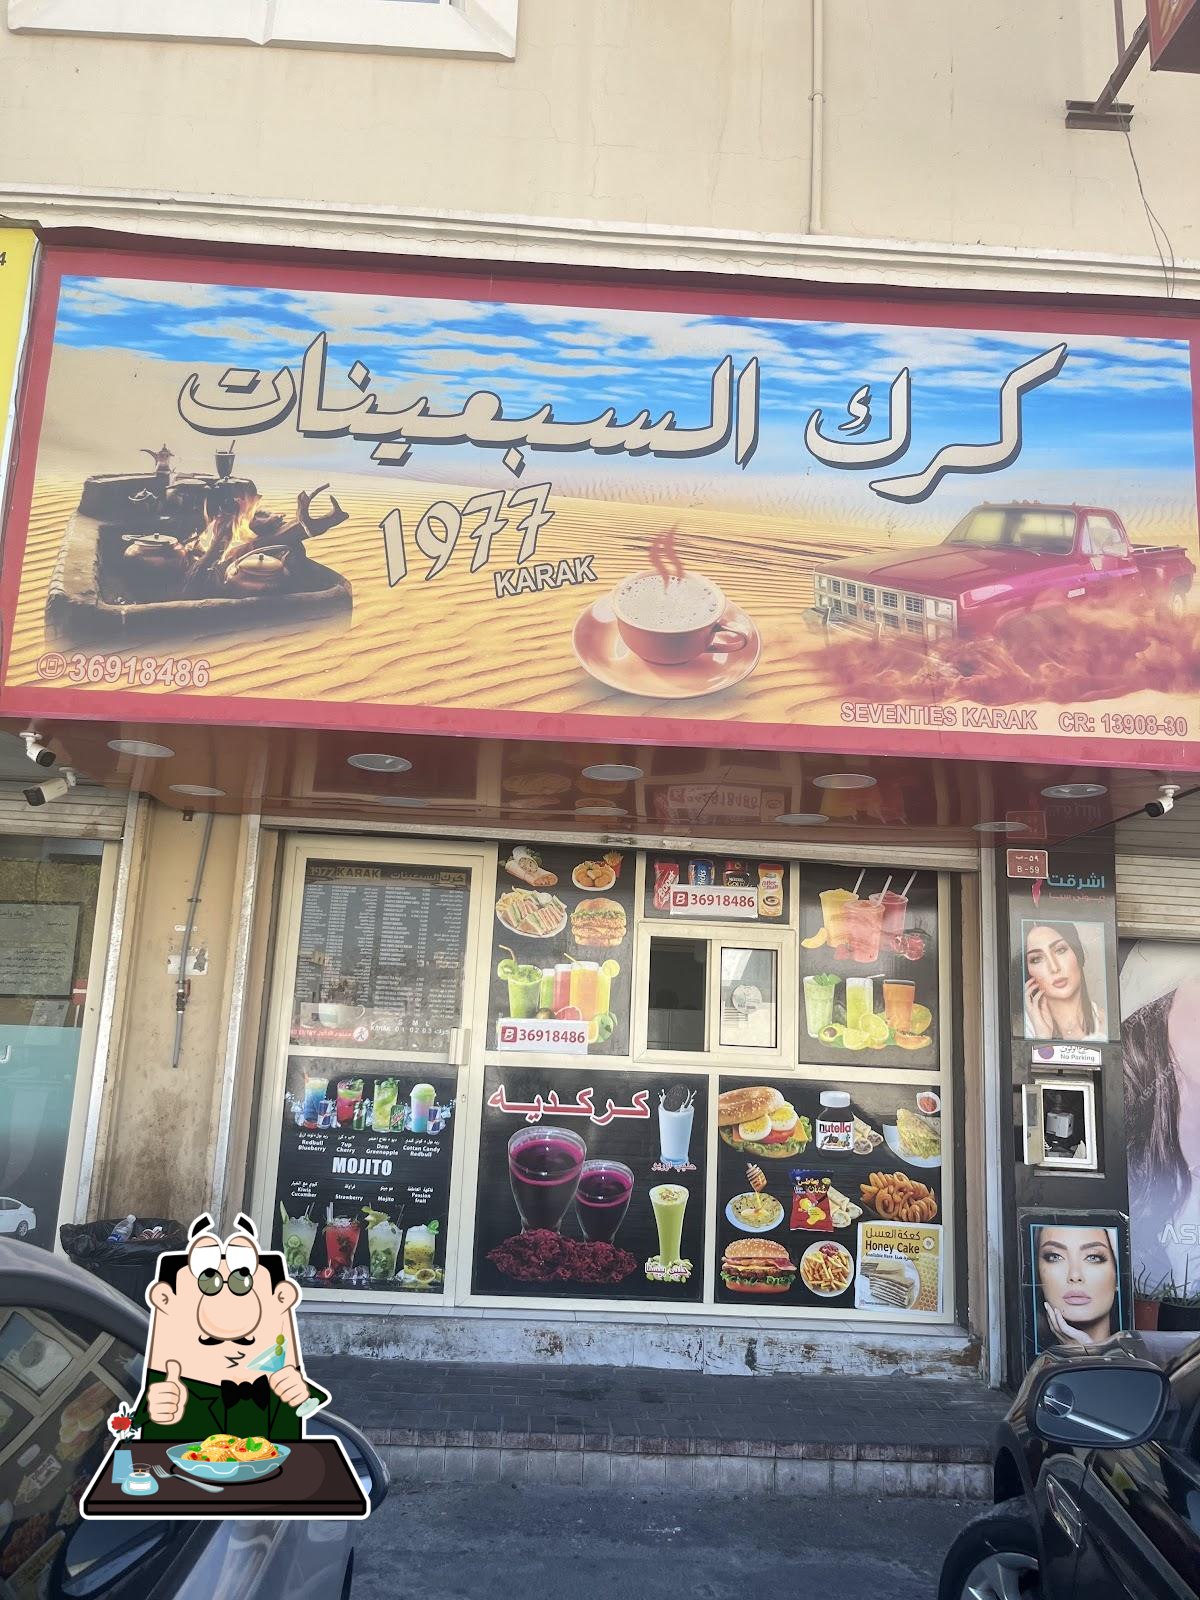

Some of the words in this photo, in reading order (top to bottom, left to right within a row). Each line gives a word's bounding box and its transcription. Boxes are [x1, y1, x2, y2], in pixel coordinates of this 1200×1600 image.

[177, 331, 761, 478] السبعينات
[805, 342, 1069, 505] كرك
[379, 482, 556, 588] 1977
[494, 555, 599, 598] KARAK
[69, 653, 210, 688] 36918486
[840, 701, 957, 727] SEVENTIES
[962, 707, 1038, 730] KARAK
[1058, 712, 1095, 732] CR:
[1100, 713, 1188, 736] 13908-30
[336, 866, 381, 880] KARAK
[691, 893, 755, 907] 36918486
[519, 1028, 585, 1044] 36918486
[488, 1084, 650, 1125] كركديه
[819, 1121, 851, 1133] nutella
[423, 1146, 441, 1154] Candy
[332, 1157, 393, 1176] MOJITO
[865, 1228, 897, 1239] العسل
[897, 1229, 921, 1241] كعكة
[865, 1240, 894, 1254] Honey
[896, 1243, 920, 1254] Cake
